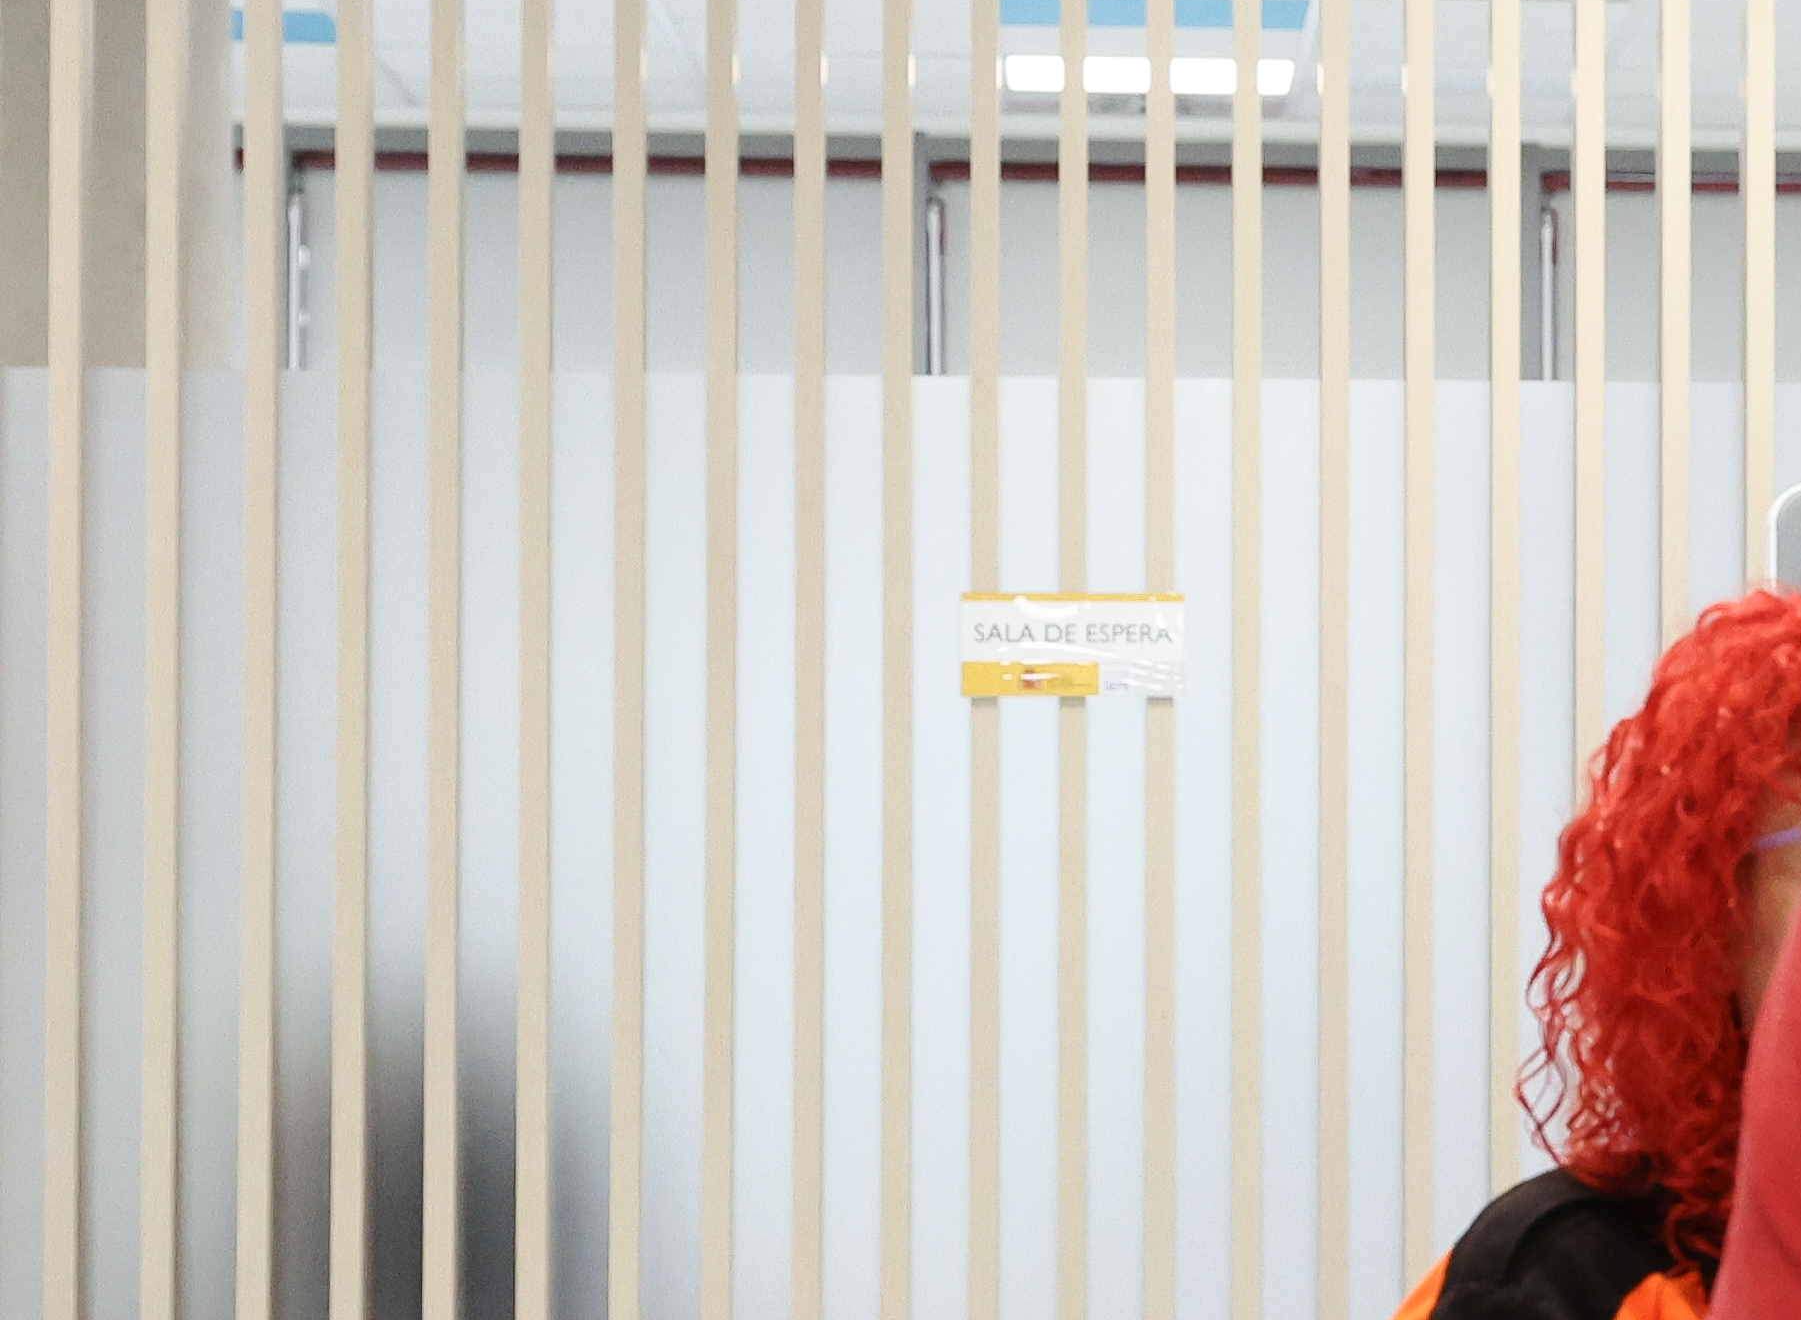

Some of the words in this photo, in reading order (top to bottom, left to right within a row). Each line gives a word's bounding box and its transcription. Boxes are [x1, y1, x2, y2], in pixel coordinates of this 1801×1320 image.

[973, 621, 1035, 643] SALA
[1044, 623, 1076, 643] DE
[1085, 623, 1174, 644] ESPERA
